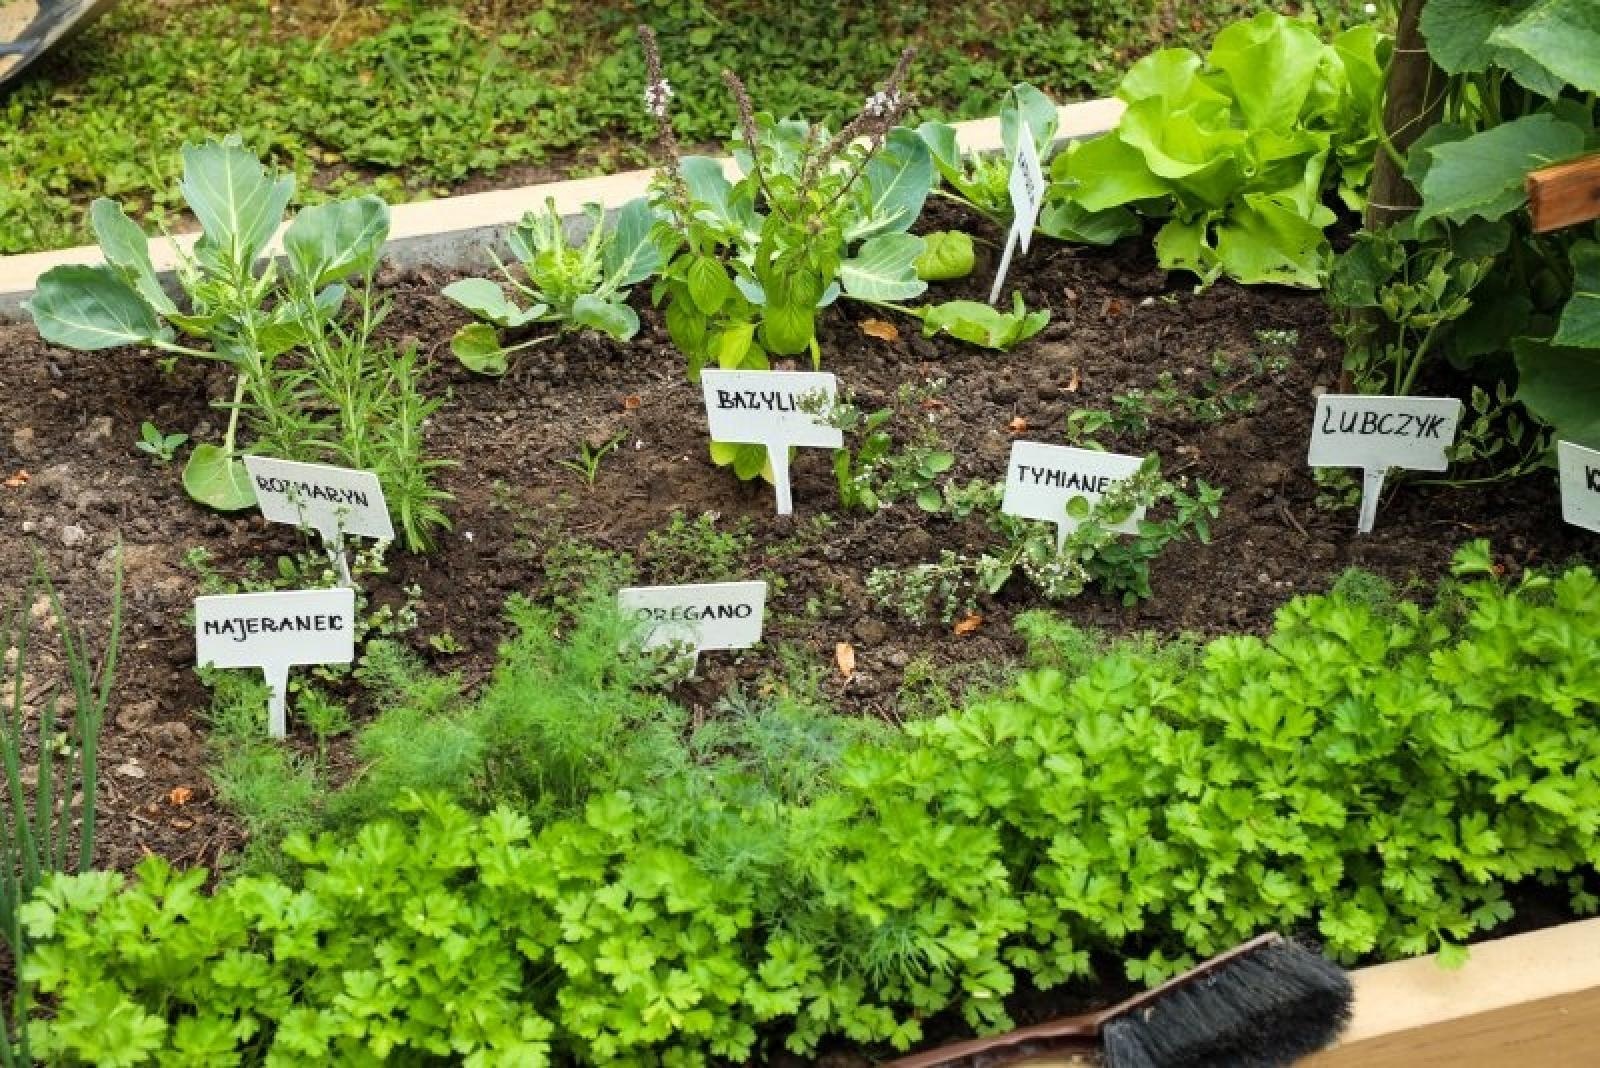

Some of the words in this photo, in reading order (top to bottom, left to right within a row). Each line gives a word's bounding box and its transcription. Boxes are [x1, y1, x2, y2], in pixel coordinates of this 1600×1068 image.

[716, 389, 813, 411] BAZYLI
[1322, 405, 1445, 438] LUBCZYK
[1018, 465, 1126, 497] TYMIANE
[636, 603, 753, 621] OREGANO
[203, 614, 343, 642] MAJERANEK
